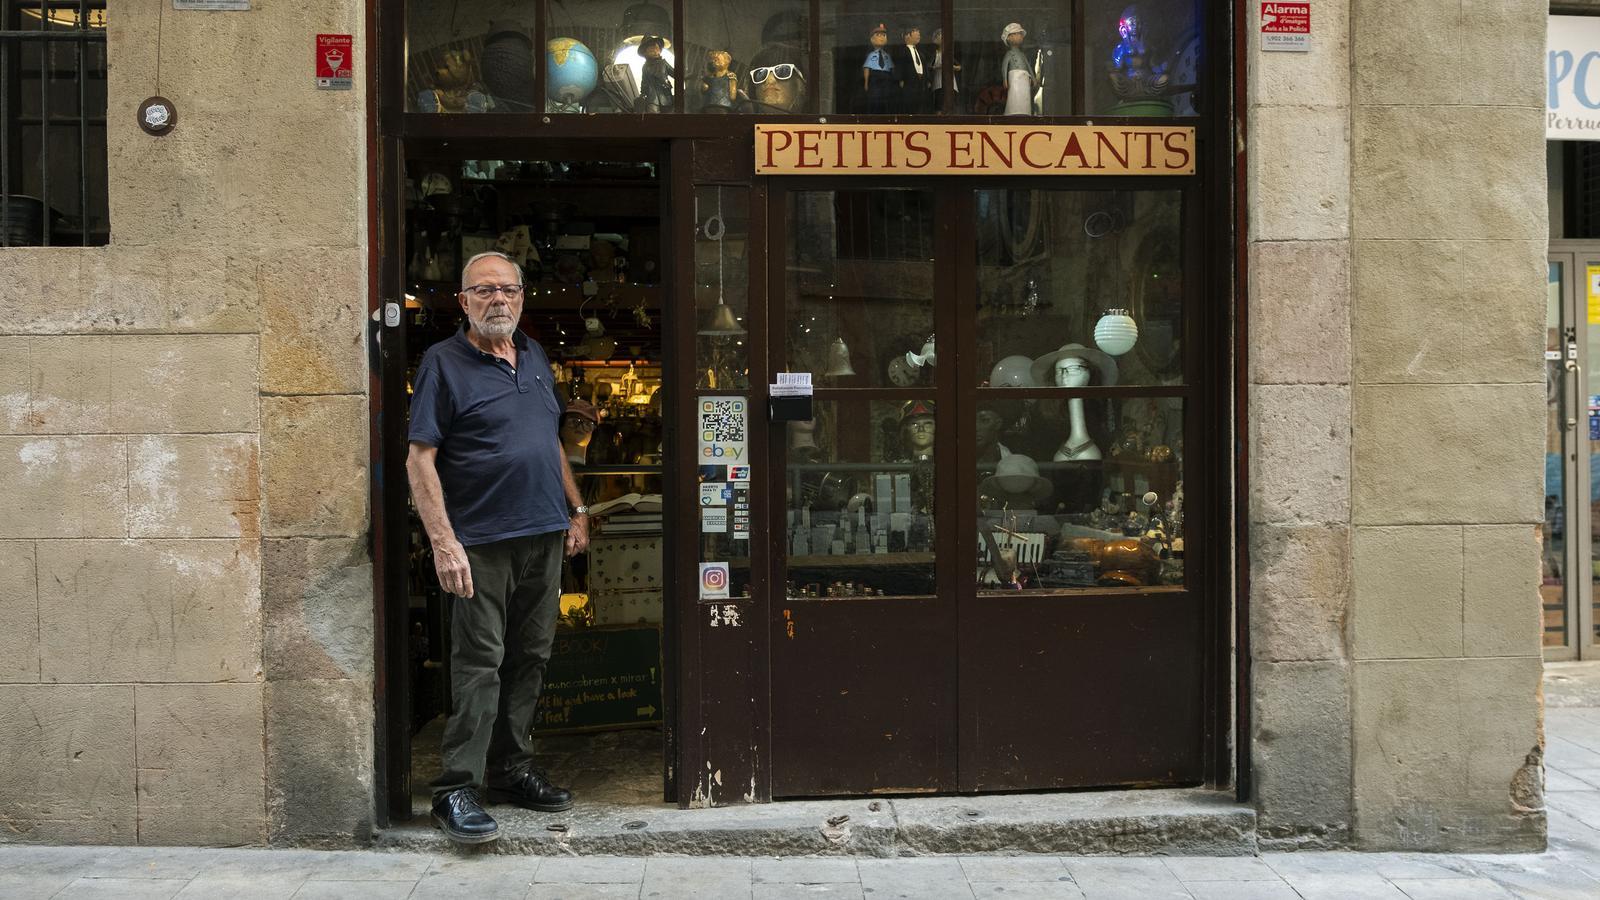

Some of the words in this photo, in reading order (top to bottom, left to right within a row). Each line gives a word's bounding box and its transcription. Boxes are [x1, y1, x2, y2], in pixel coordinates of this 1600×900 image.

[1264, 3, 1308, 14] Alarma
[319, 36, 351, 45] Vigilante
[760, 130, 933, 169] PETITS
[945, 130, 1191, 170] ENCANTS
[702, 443, 743, 460] ebay
